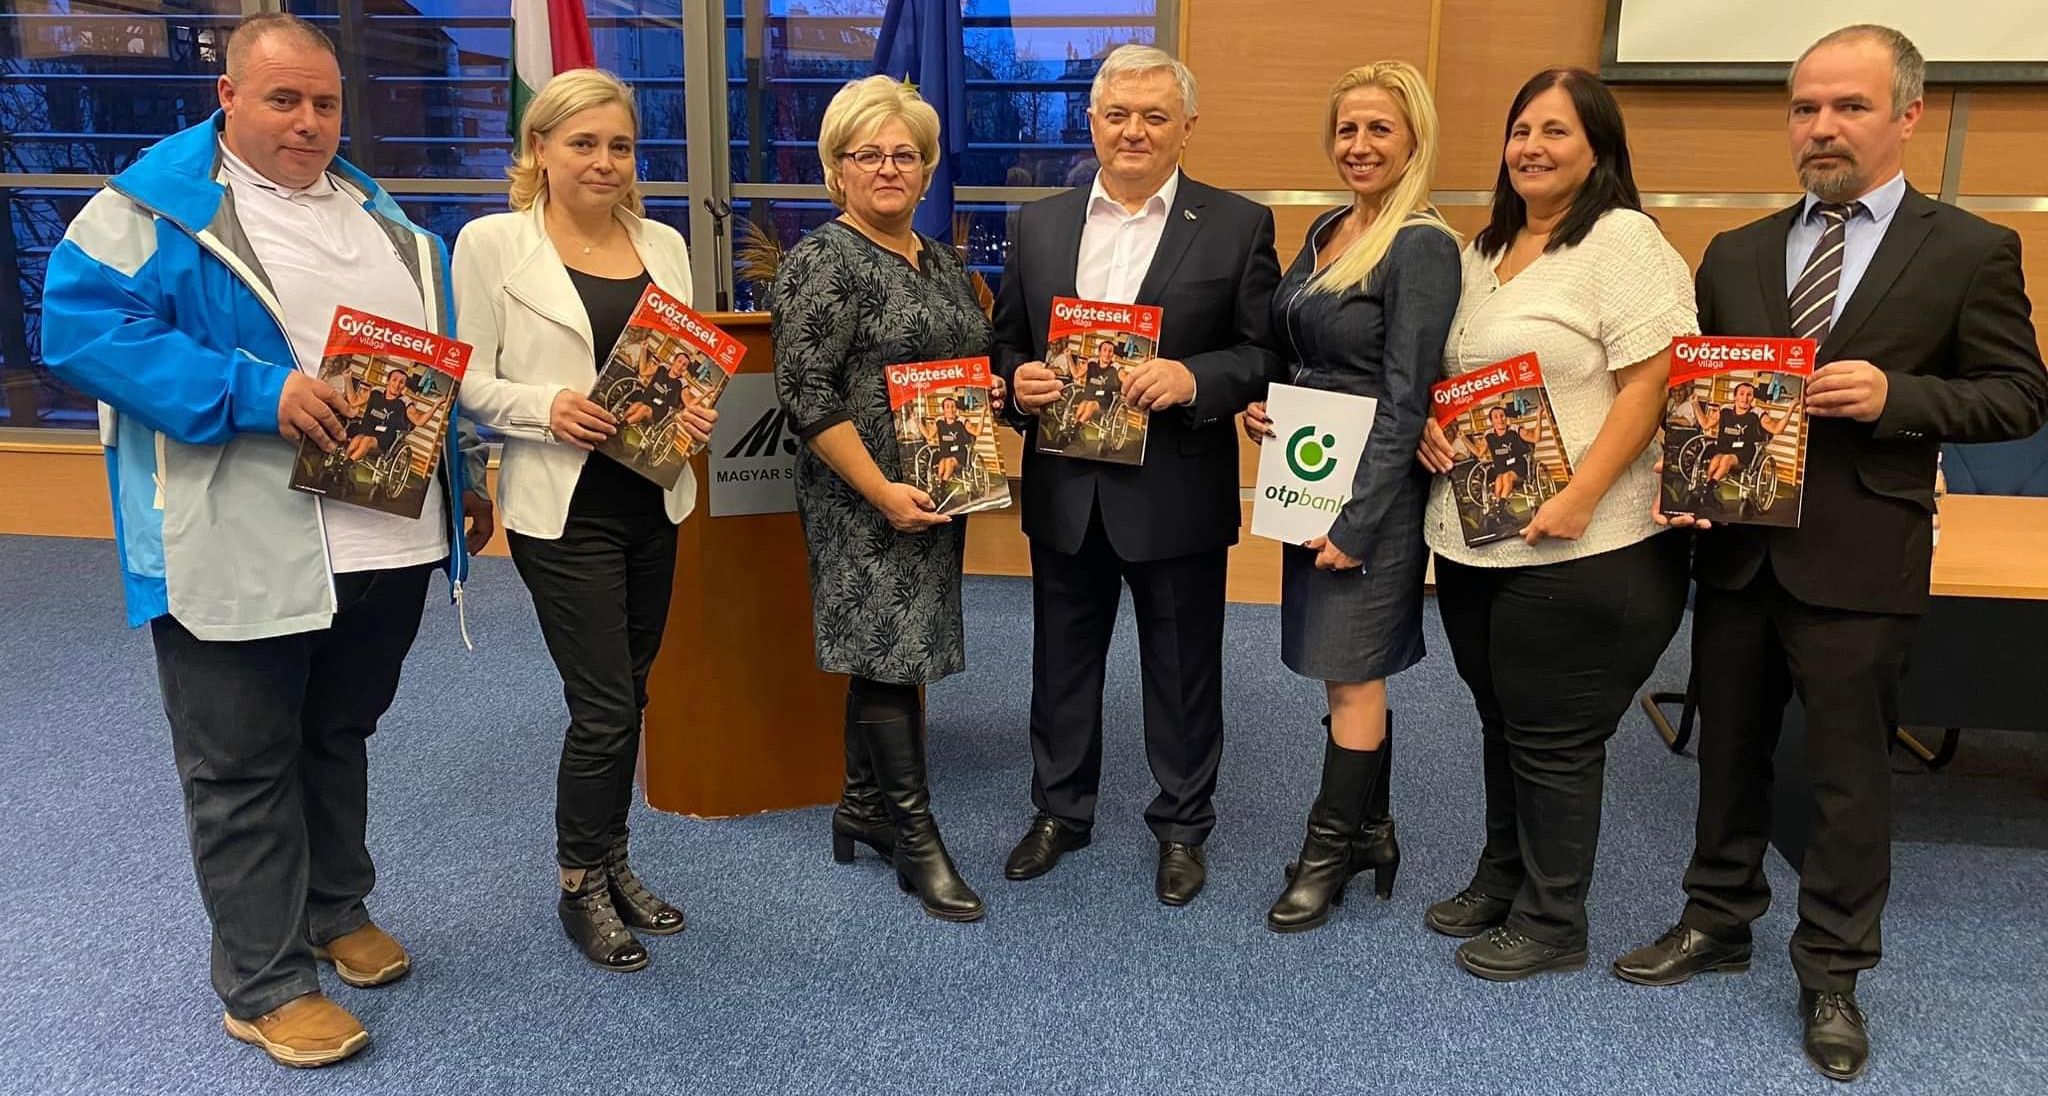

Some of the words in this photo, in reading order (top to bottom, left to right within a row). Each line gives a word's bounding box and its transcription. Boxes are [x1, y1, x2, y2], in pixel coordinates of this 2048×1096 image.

[1055, 303, 1131, 324] Győztesek
[337, 314, 435, 356] Győztesek
[359, 337, 385, 350] világa
[1675, 342, 1776, 363] Győztesek
[1697, 360, 1724, 370] világa
[1434, 368, 1510, 405] Győztesek
[716, 468, 780, 483] MAGYAR
